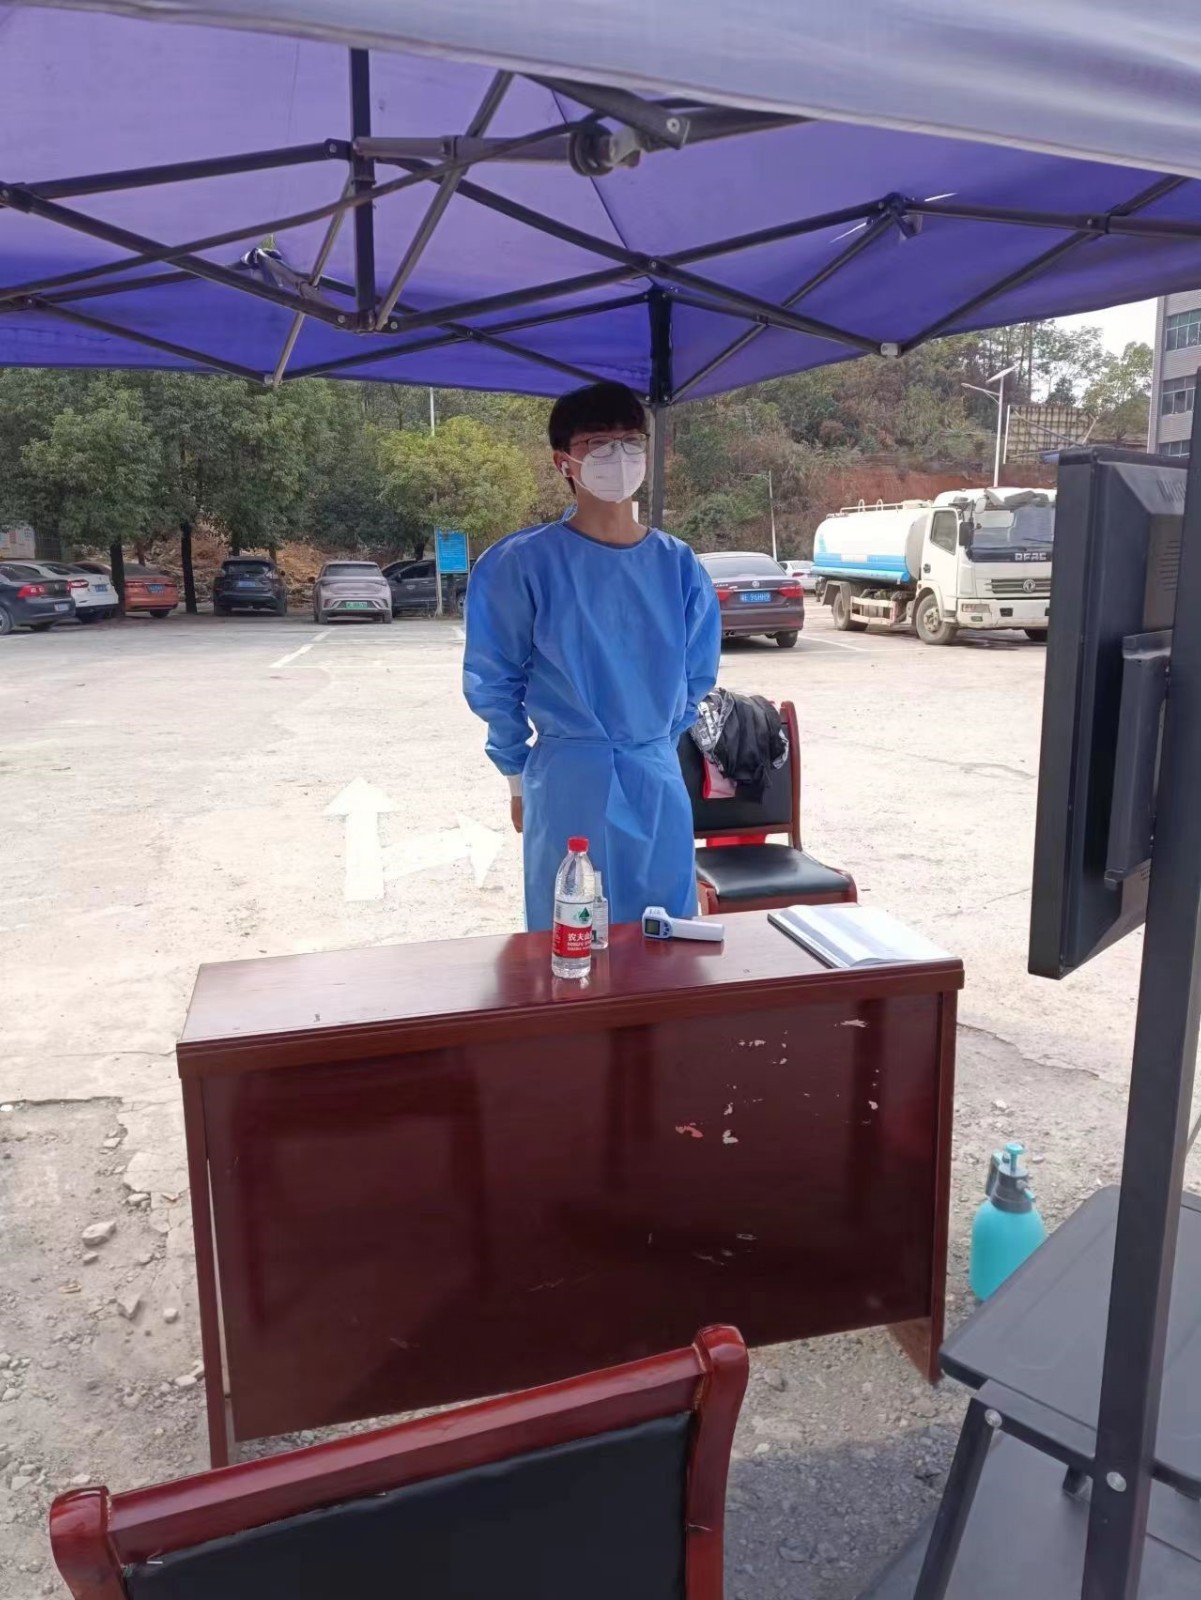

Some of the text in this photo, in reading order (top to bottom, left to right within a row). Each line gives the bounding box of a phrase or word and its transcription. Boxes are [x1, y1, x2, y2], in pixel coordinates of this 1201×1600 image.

[1014, 552, 1047, 561] DFAC
[567, 931, 591, 941] 农夫山
